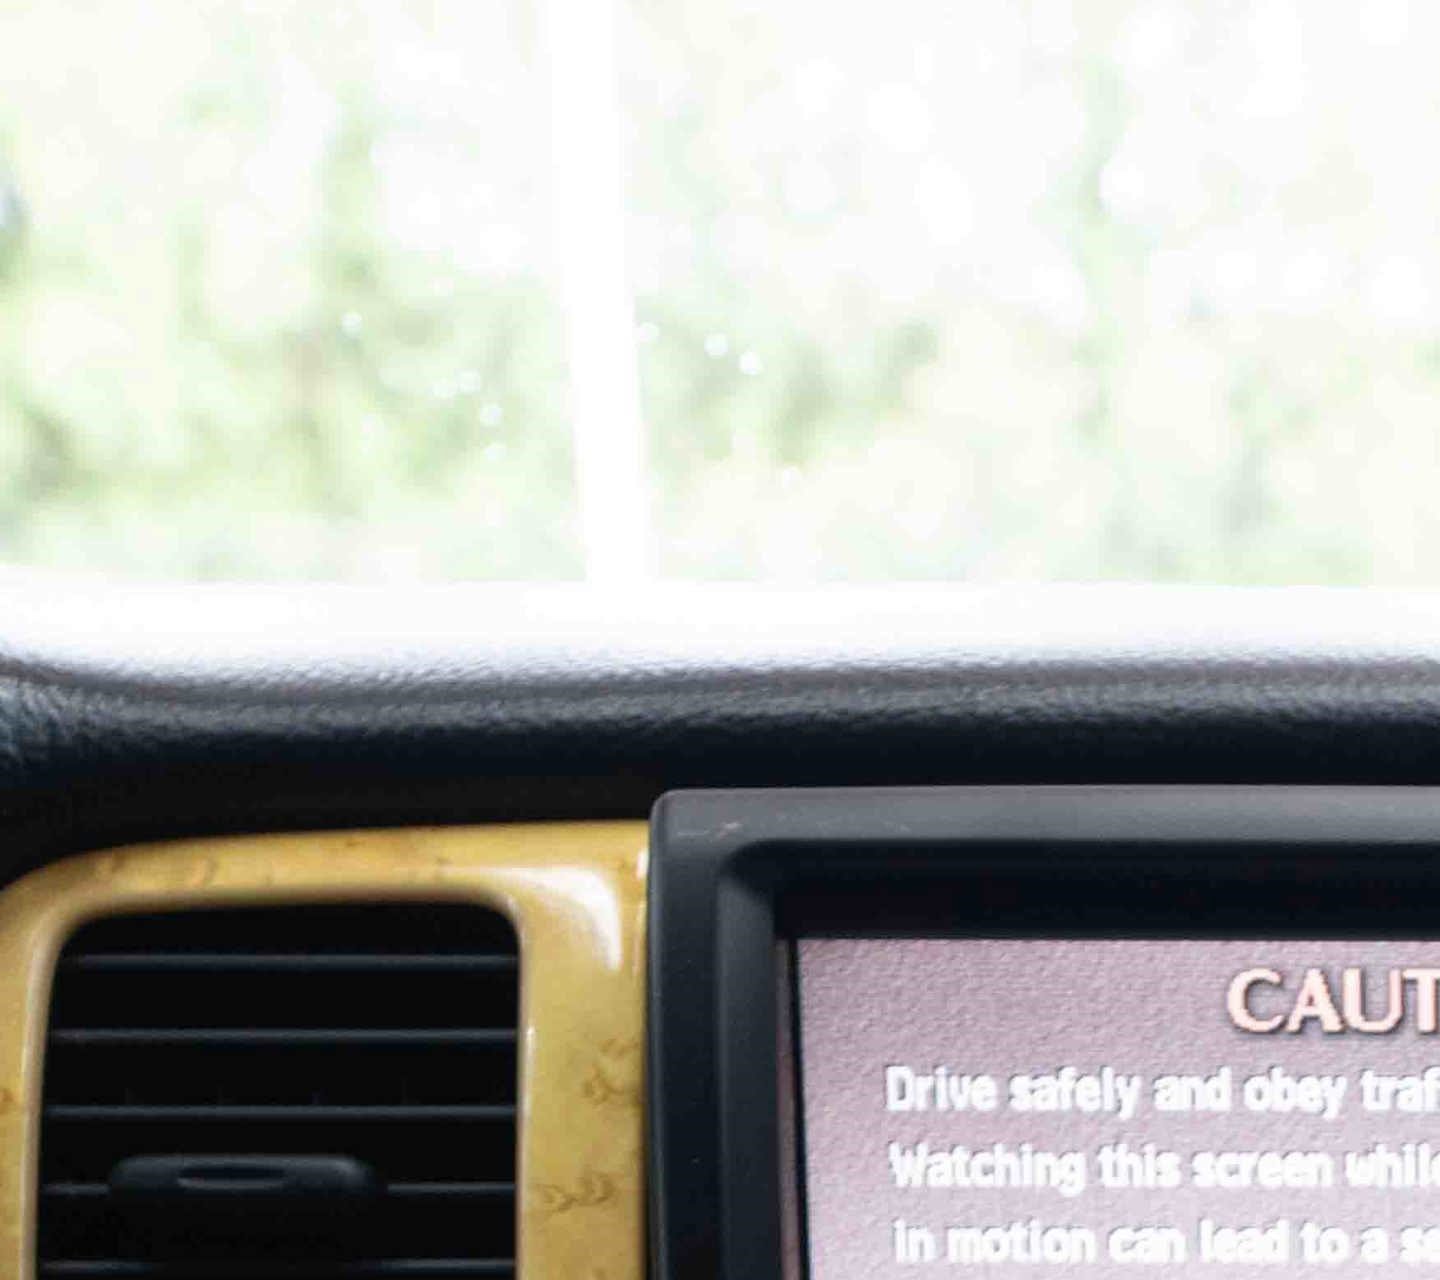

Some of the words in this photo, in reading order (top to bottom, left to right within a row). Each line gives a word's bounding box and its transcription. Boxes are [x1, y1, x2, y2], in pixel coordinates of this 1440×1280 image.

[886, 1066, 997, 1111] Drive
[1008, 1066, 1141, 1119] safely
[1154, 1067, 1231, 1111] and
[1244, 1067, 1347, 1119] obey
[889, 1142, 1086, 1196] Watching
[1098, 1142, 1181, 1187] this
[1191, 1151, 1334, 1187] screen
[947, 1218, 1096, 1263] motion
[1108, 1226, 1186, 1263] can
[1200, 1218, 1289, 1263] lead
[1298, 1221, 1350, 1263] to
[1361, 1226, 1389, 1263] a
